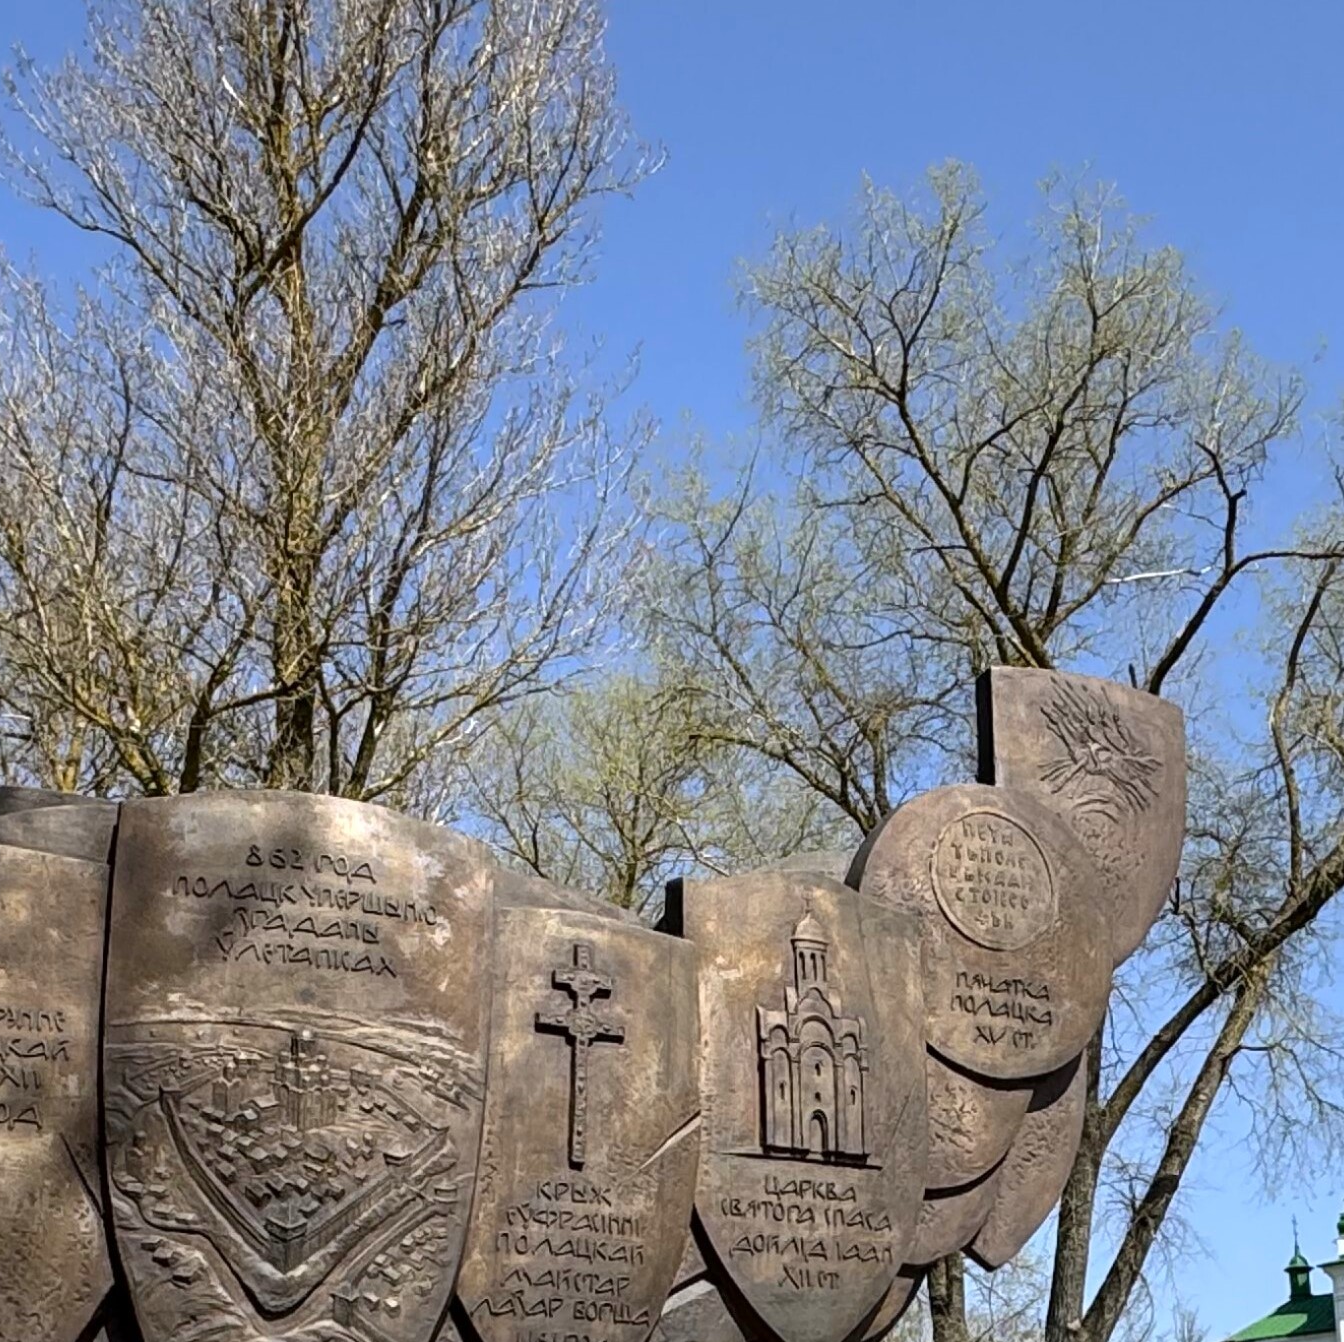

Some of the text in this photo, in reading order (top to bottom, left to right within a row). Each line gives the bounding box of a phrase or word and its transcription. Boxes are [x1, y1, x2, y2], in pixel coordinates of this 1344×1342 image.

[244, 844, 378, 884] 862 ГОД
[172, 875, 298, 907] ПОЛАЦК
[233, 905, 381, 945] ЗГАДАНЫ
[956, 970, 1050, 1001] ПЯЧАТКА
[950, 994, 1053, 1026] ПОЛАЦКА
[535, 1180, 612, 1207] КРЫЖ
[763, 1174, 858, 1202] ЦАРКВА
[720, 1197, 893, 1232] СВЯТОГА СПАСА
[495, 1231, 645, 1265] ПОЛАЦКАЙ
[728, 1233, 828, 1262] ДОЙЛІД
[499, 1268, 631, 1298] МАЙСТАР
[468, 1289, 651, 1328] ЛАЗАР БОГША
